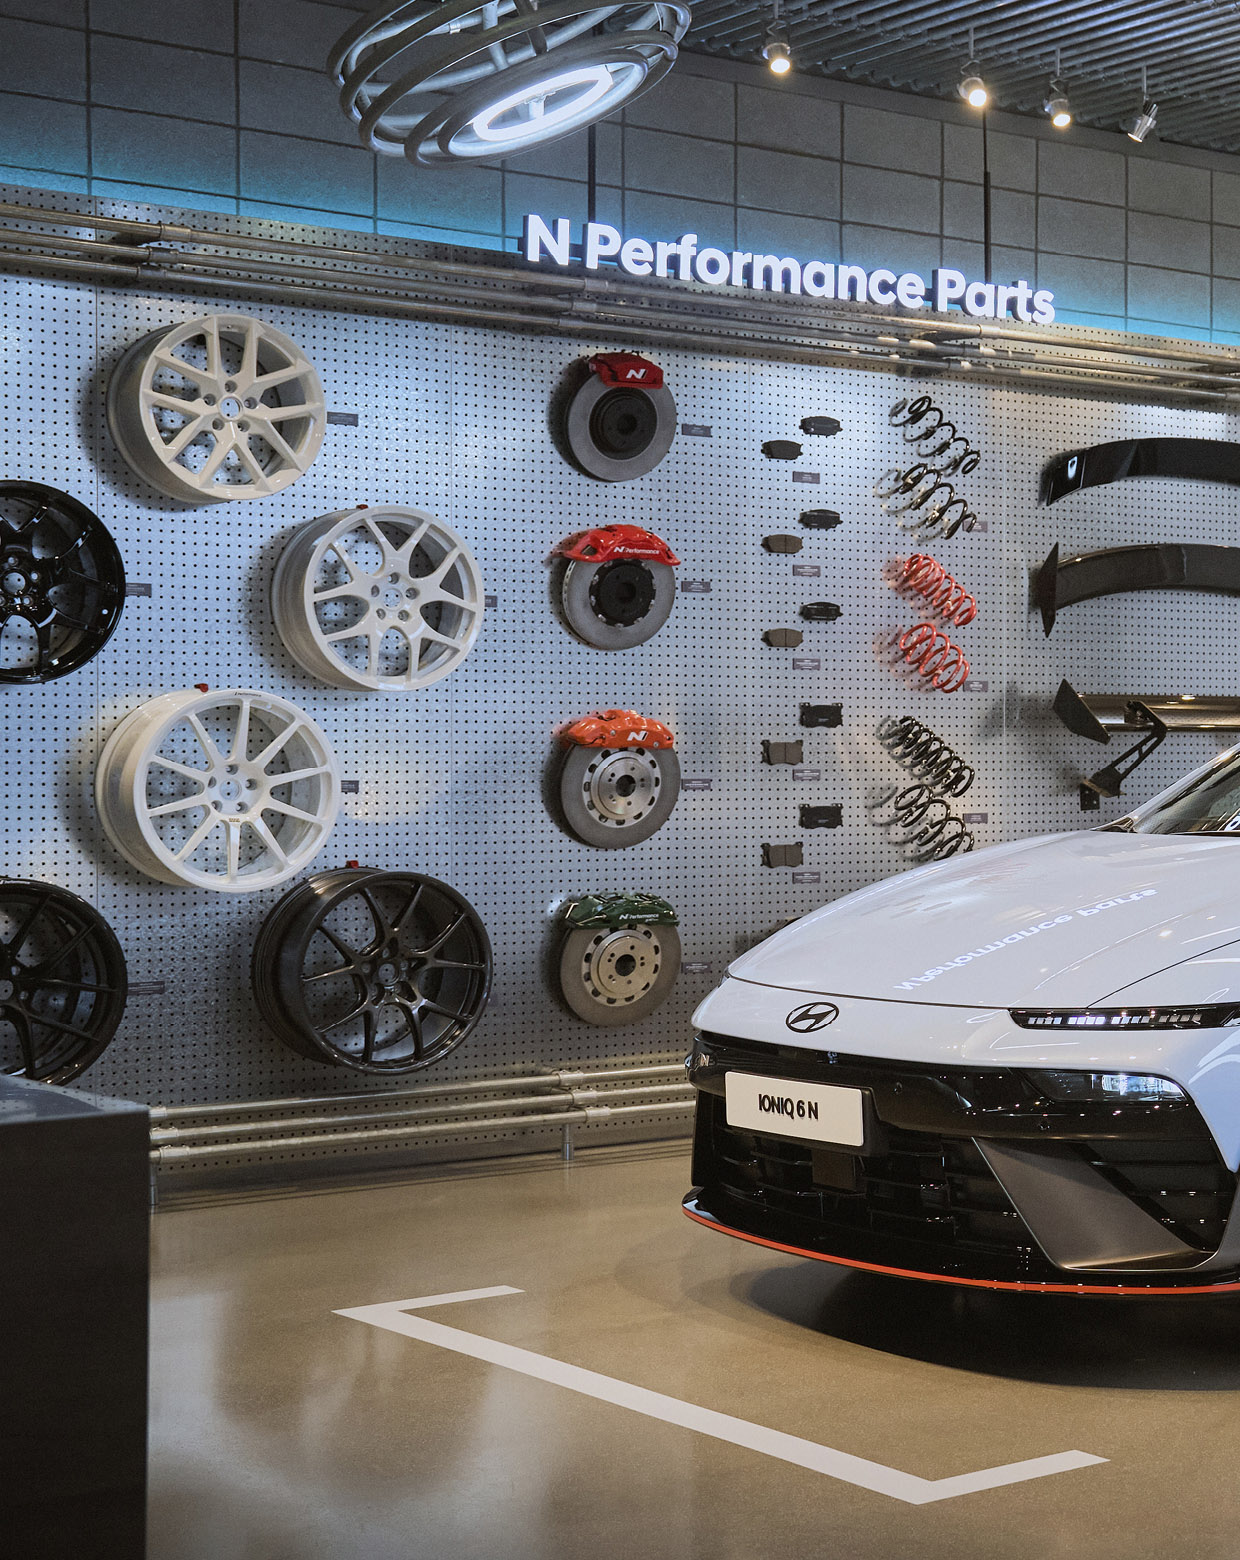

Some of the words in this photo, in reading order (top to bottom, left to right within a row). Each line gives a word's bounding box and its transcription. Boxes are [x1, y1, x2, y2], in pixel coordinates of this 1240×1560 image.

[524, 213, 570, 265] N
[584, 221, 926, 308] Performance
[932, 267, 1057, 325] Parts
[626, 369, 647, 379] N
[627, 731, 648, 741] N
[758, 1093, 795, 1120] IONIQ
[796, 1099, 806, 1118] 6
[807, 1100, 819, 1121] N
